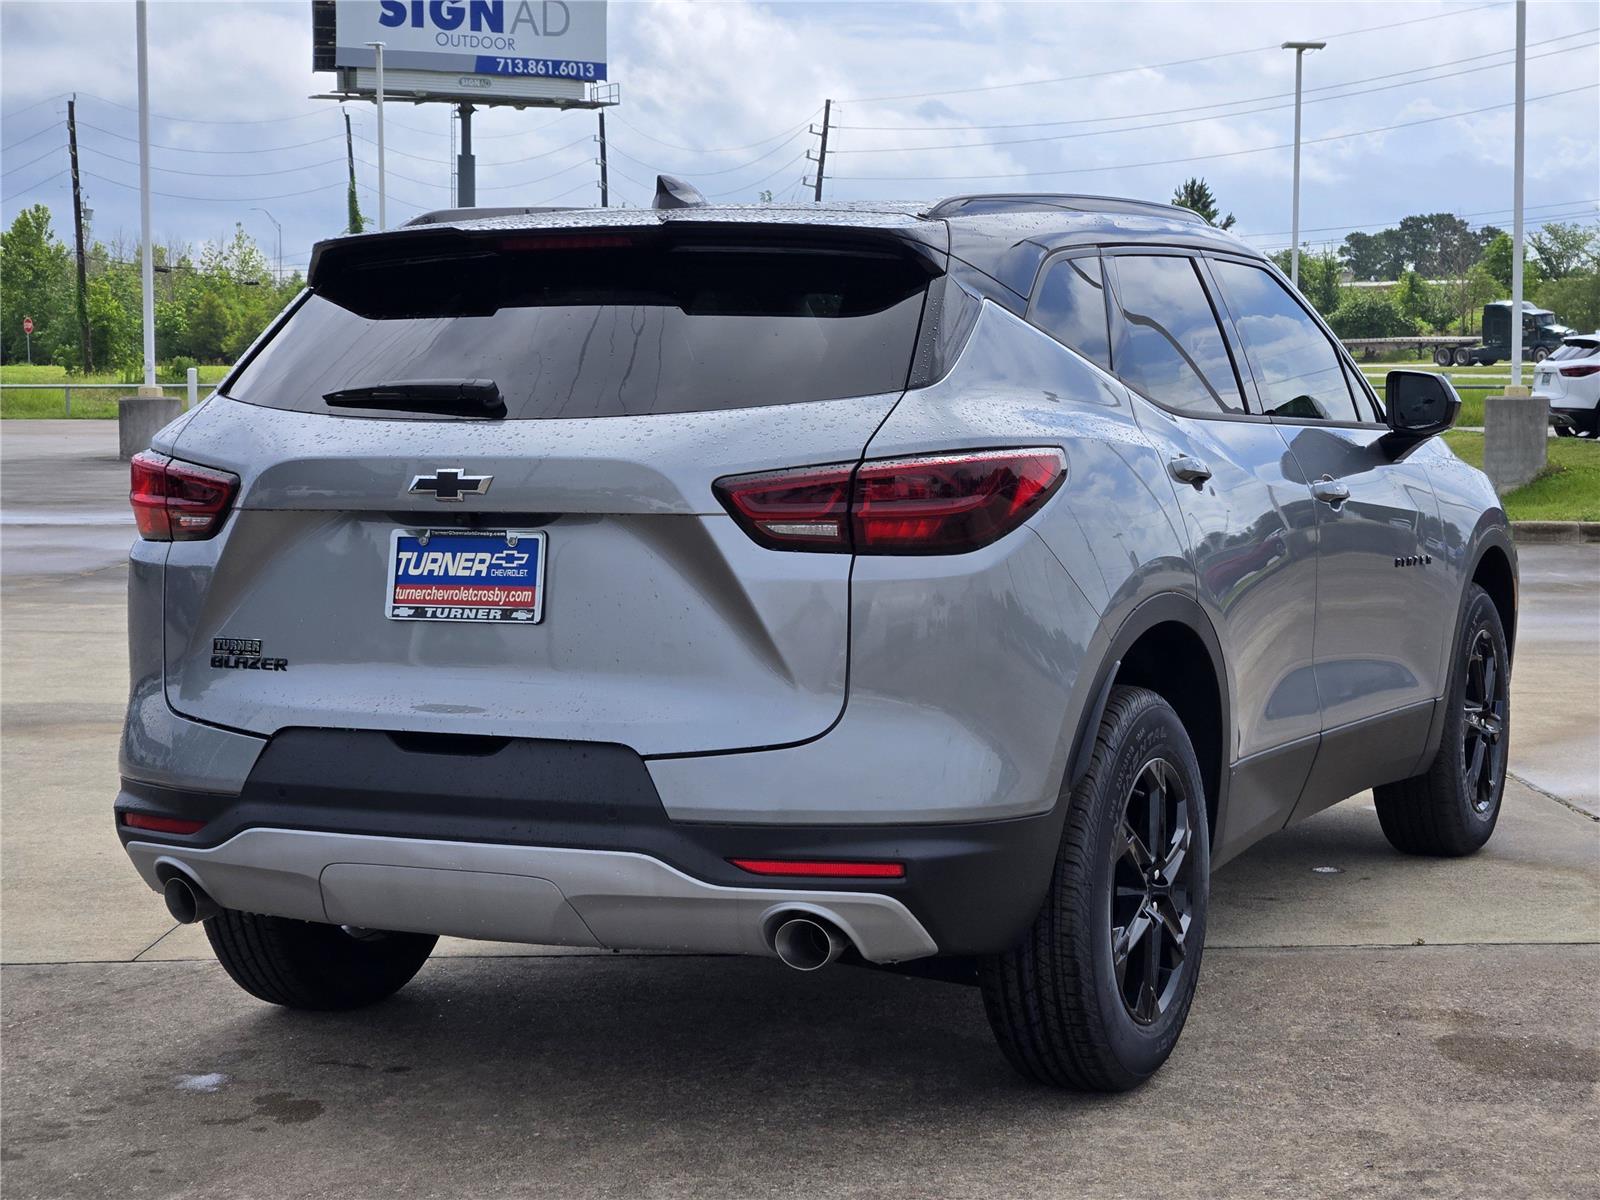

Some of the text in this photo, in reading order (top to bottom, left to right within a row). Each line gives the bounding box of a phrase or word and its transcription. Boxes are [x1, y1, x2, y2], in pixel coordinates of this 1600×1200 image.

[379, 0, 571, 37] SIGN AD
[435, 32, 516, 51] OUTDOOR
[496, 58, 595, 77] 713.861.6013
[398, 552, 491, 577] TURNER
[491, 569, 528, 577] CHEVROLET
[395, 587, 532, 605] turnerchevroletcrosby.com
[424, 607, 502, 620] TURNER
[215, 640, 260, 651] TURNER
[210, 656, 288, 671] BLAZER
